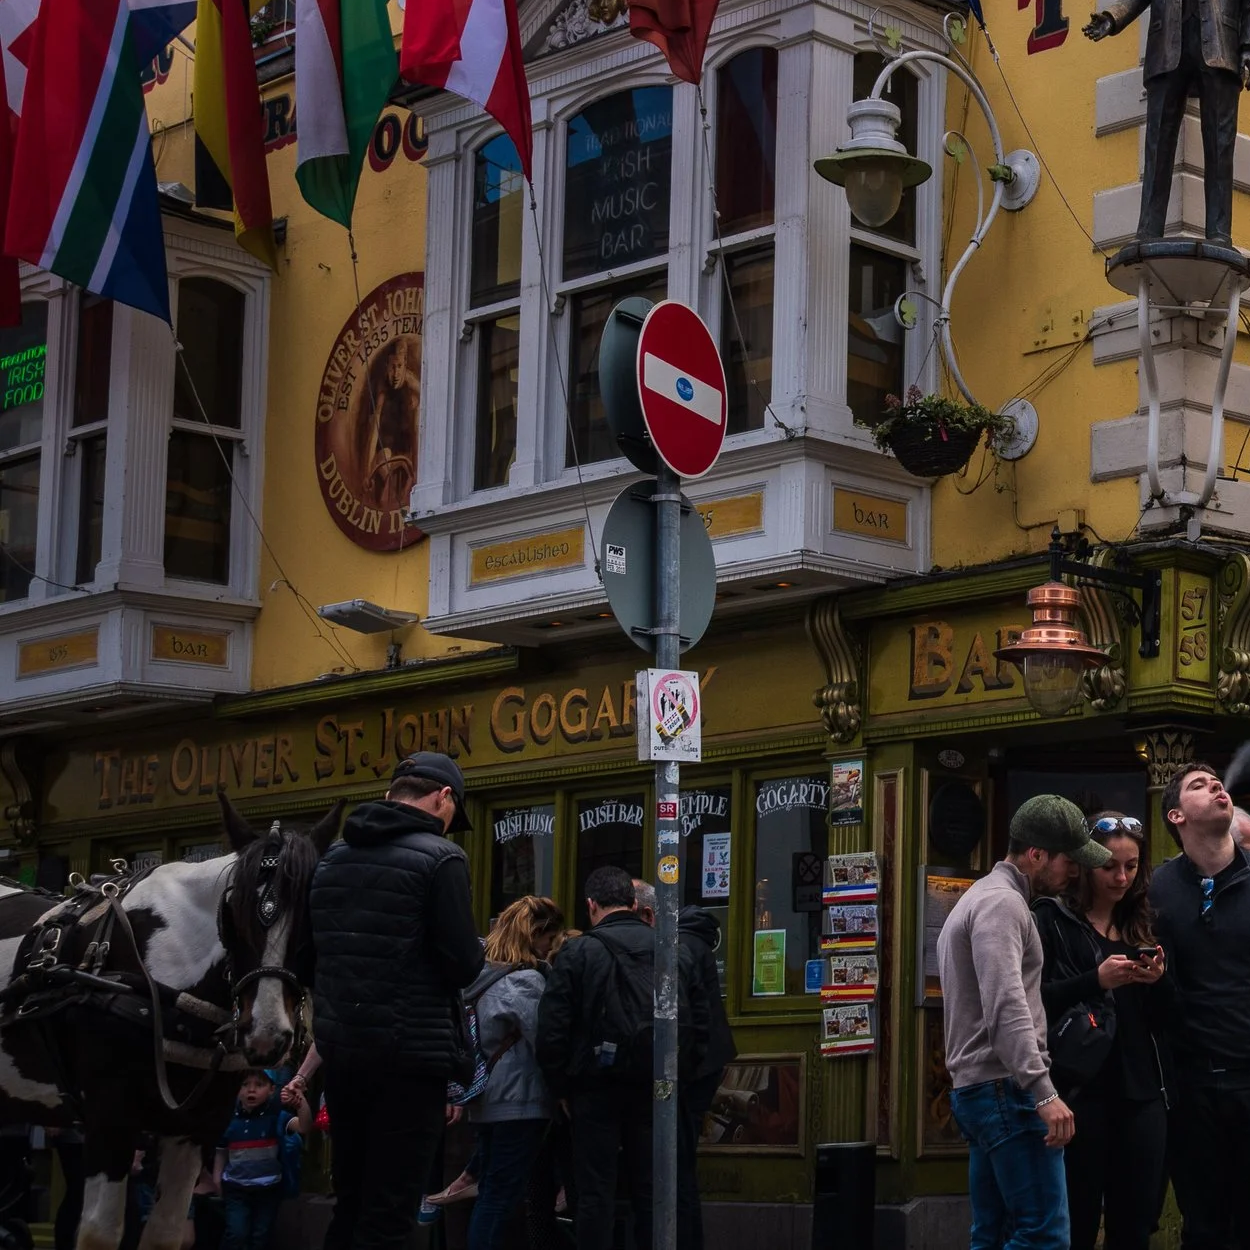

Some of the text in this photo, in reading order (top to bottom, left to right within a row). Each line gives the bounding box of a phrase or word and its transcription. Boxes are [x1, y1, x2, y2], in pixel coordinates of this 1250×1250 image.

[591, 181, 659, 225] MUSIC
[601, 223, 646, 260] BAR
[317, 327, 364, 425] OLIVER
[3, 381, 45, 410] FOOD
[319, 450, 385, 536] DUBLIN
[1180, 587, 1209, 621] 57
[1179, 630, 1209, 667] 58
[97, 748, 161, 811] THE
[170, 732, 301, 797] OLIVER
[680, 793, 729, 818] EMPLE
[755, 782, 832, 815] GOGARTY
[493, 812, 557, 843] IRISH MUSIC
[578, 802, 644, 833] IRISH BAR
